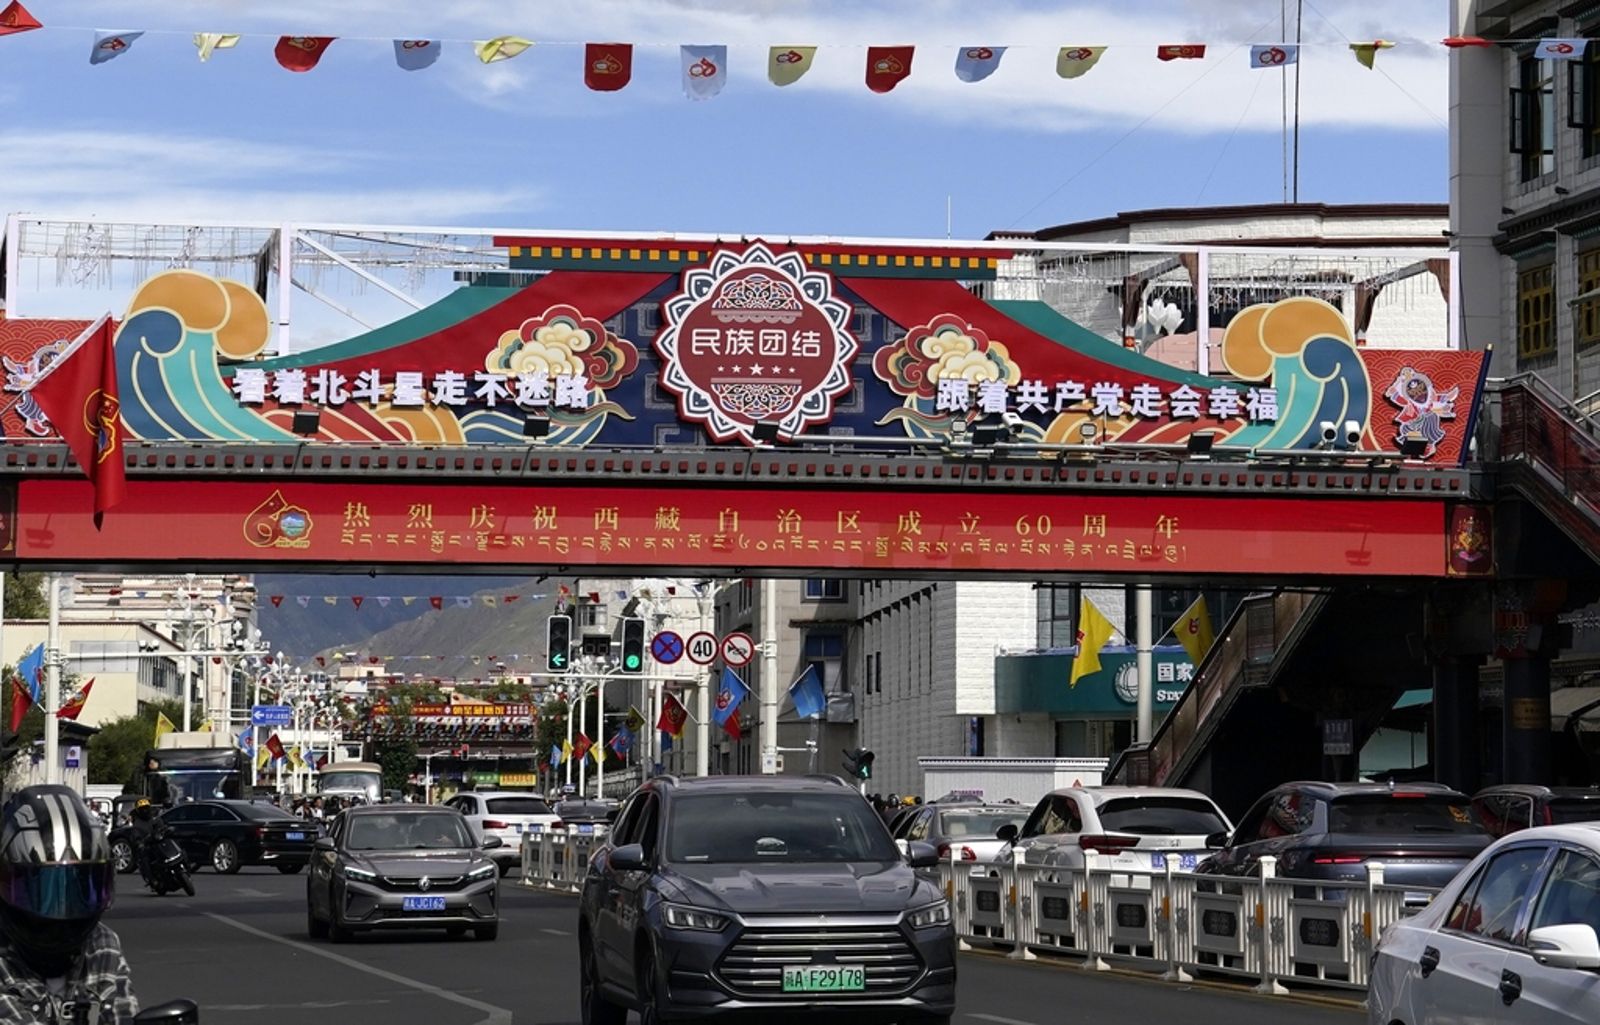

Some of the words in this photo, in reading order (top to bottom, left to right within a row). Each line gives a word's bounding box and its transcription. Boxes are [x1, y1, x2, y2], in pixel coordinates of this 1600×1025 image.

[691, 327, 822, 358] 民族团结
[231, 367, 591, 409] 看着北斗星走不迷路
[935, 377, 1280, 422] 跟着共产党走会幸福
[692, 639, 713, 658] 40
[1157, 662, 1193, 682] 国家
